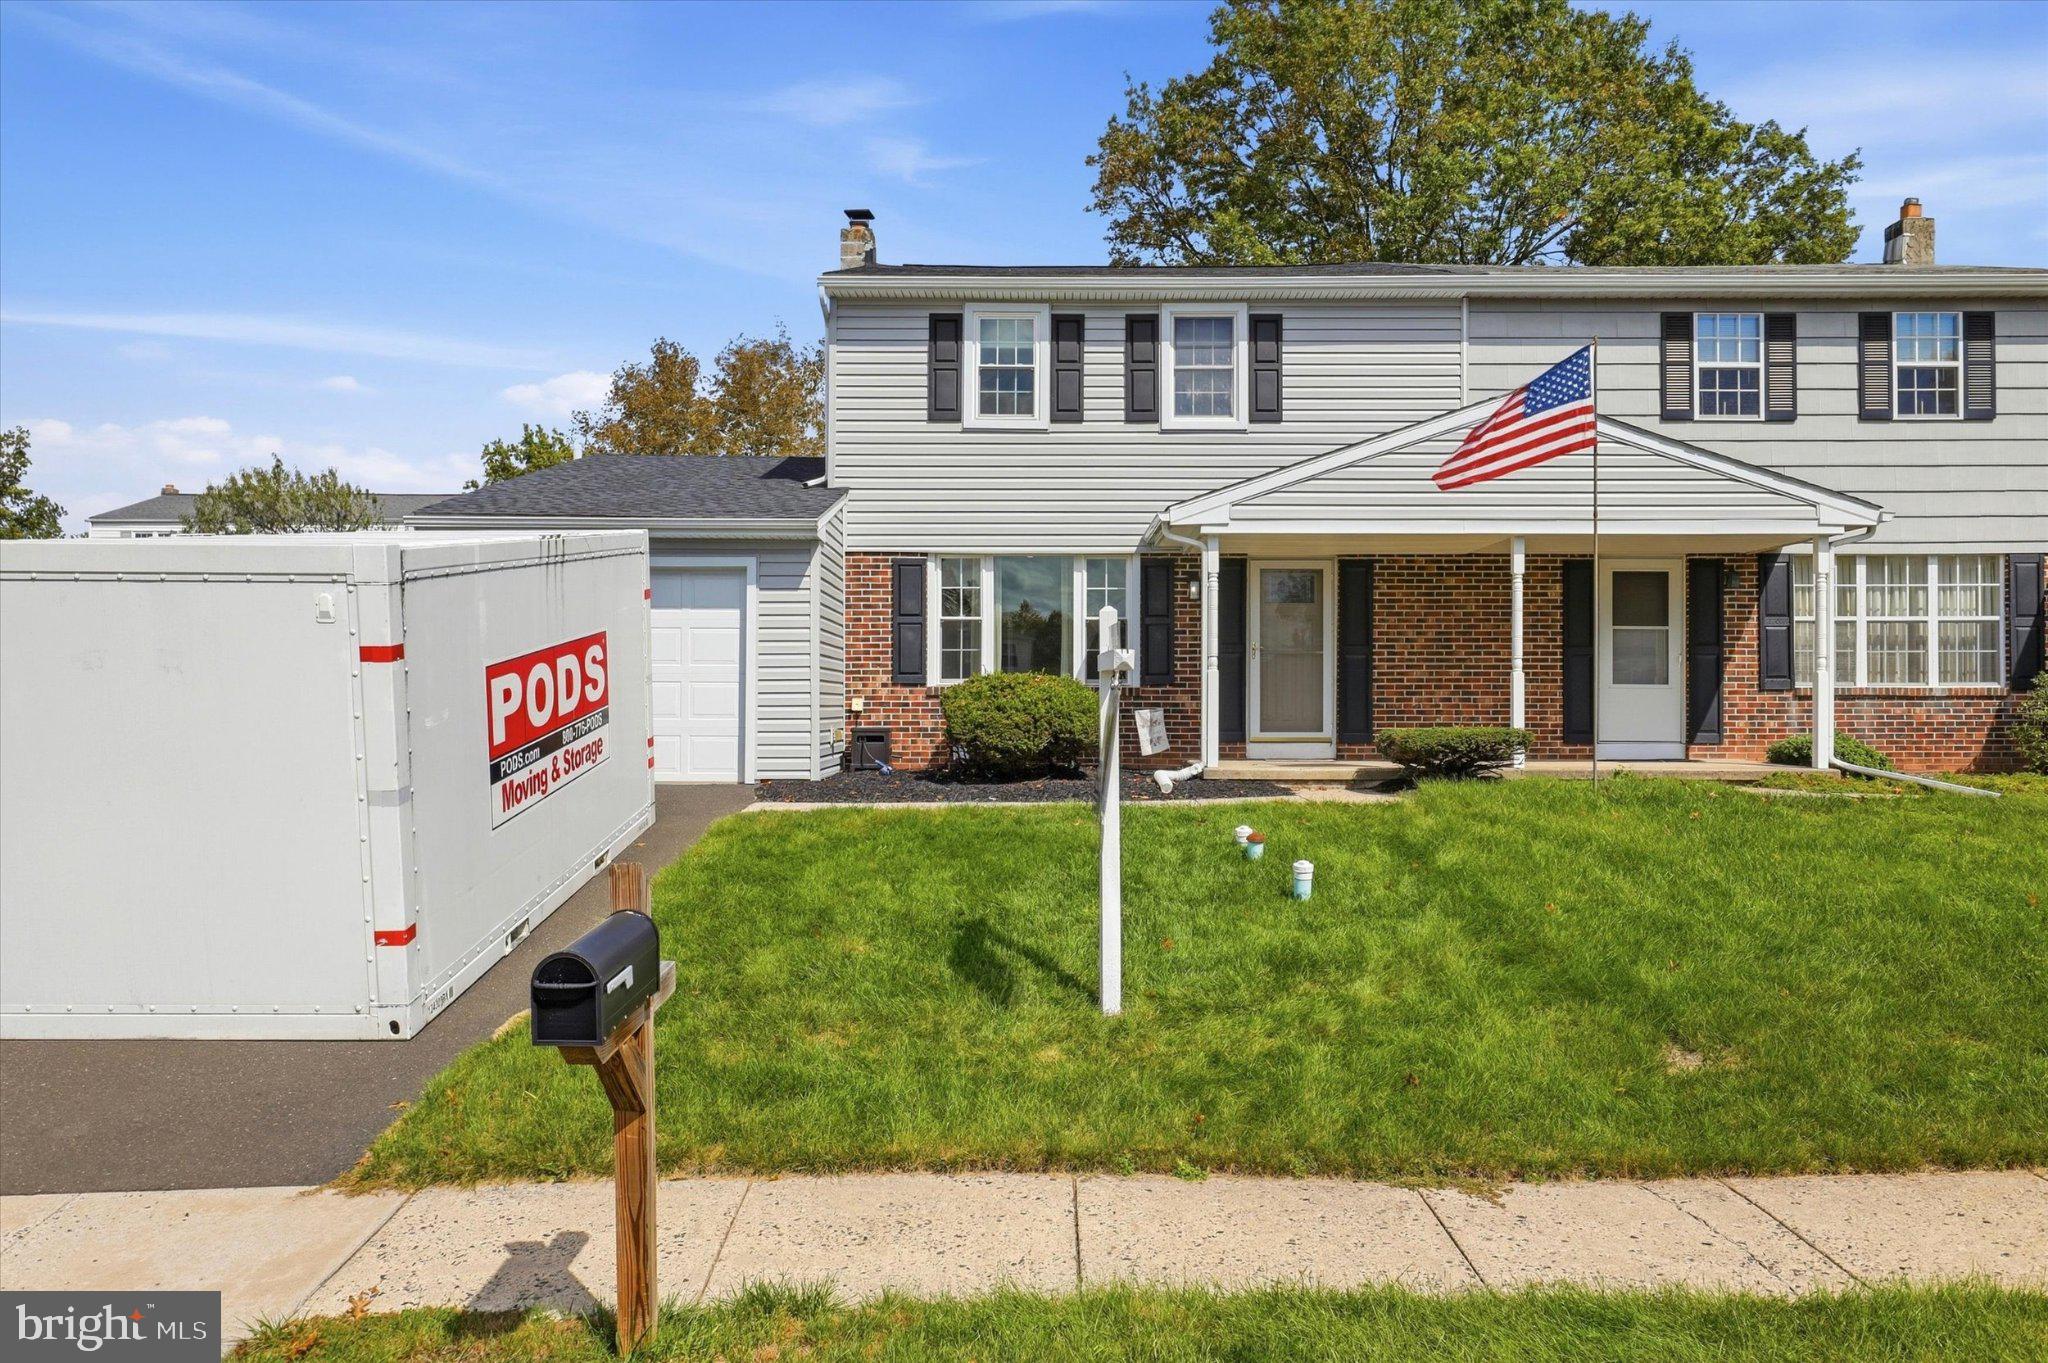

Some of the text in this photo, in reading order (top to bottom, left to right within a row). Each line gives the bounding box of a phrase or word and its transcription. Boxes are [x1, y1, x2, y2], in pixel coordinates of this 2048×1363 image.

[490, 644, 605, 746] PODS
[500, 746, 541, 778] PODS.com
[501, 737, 604, 813] Moving & Storage
